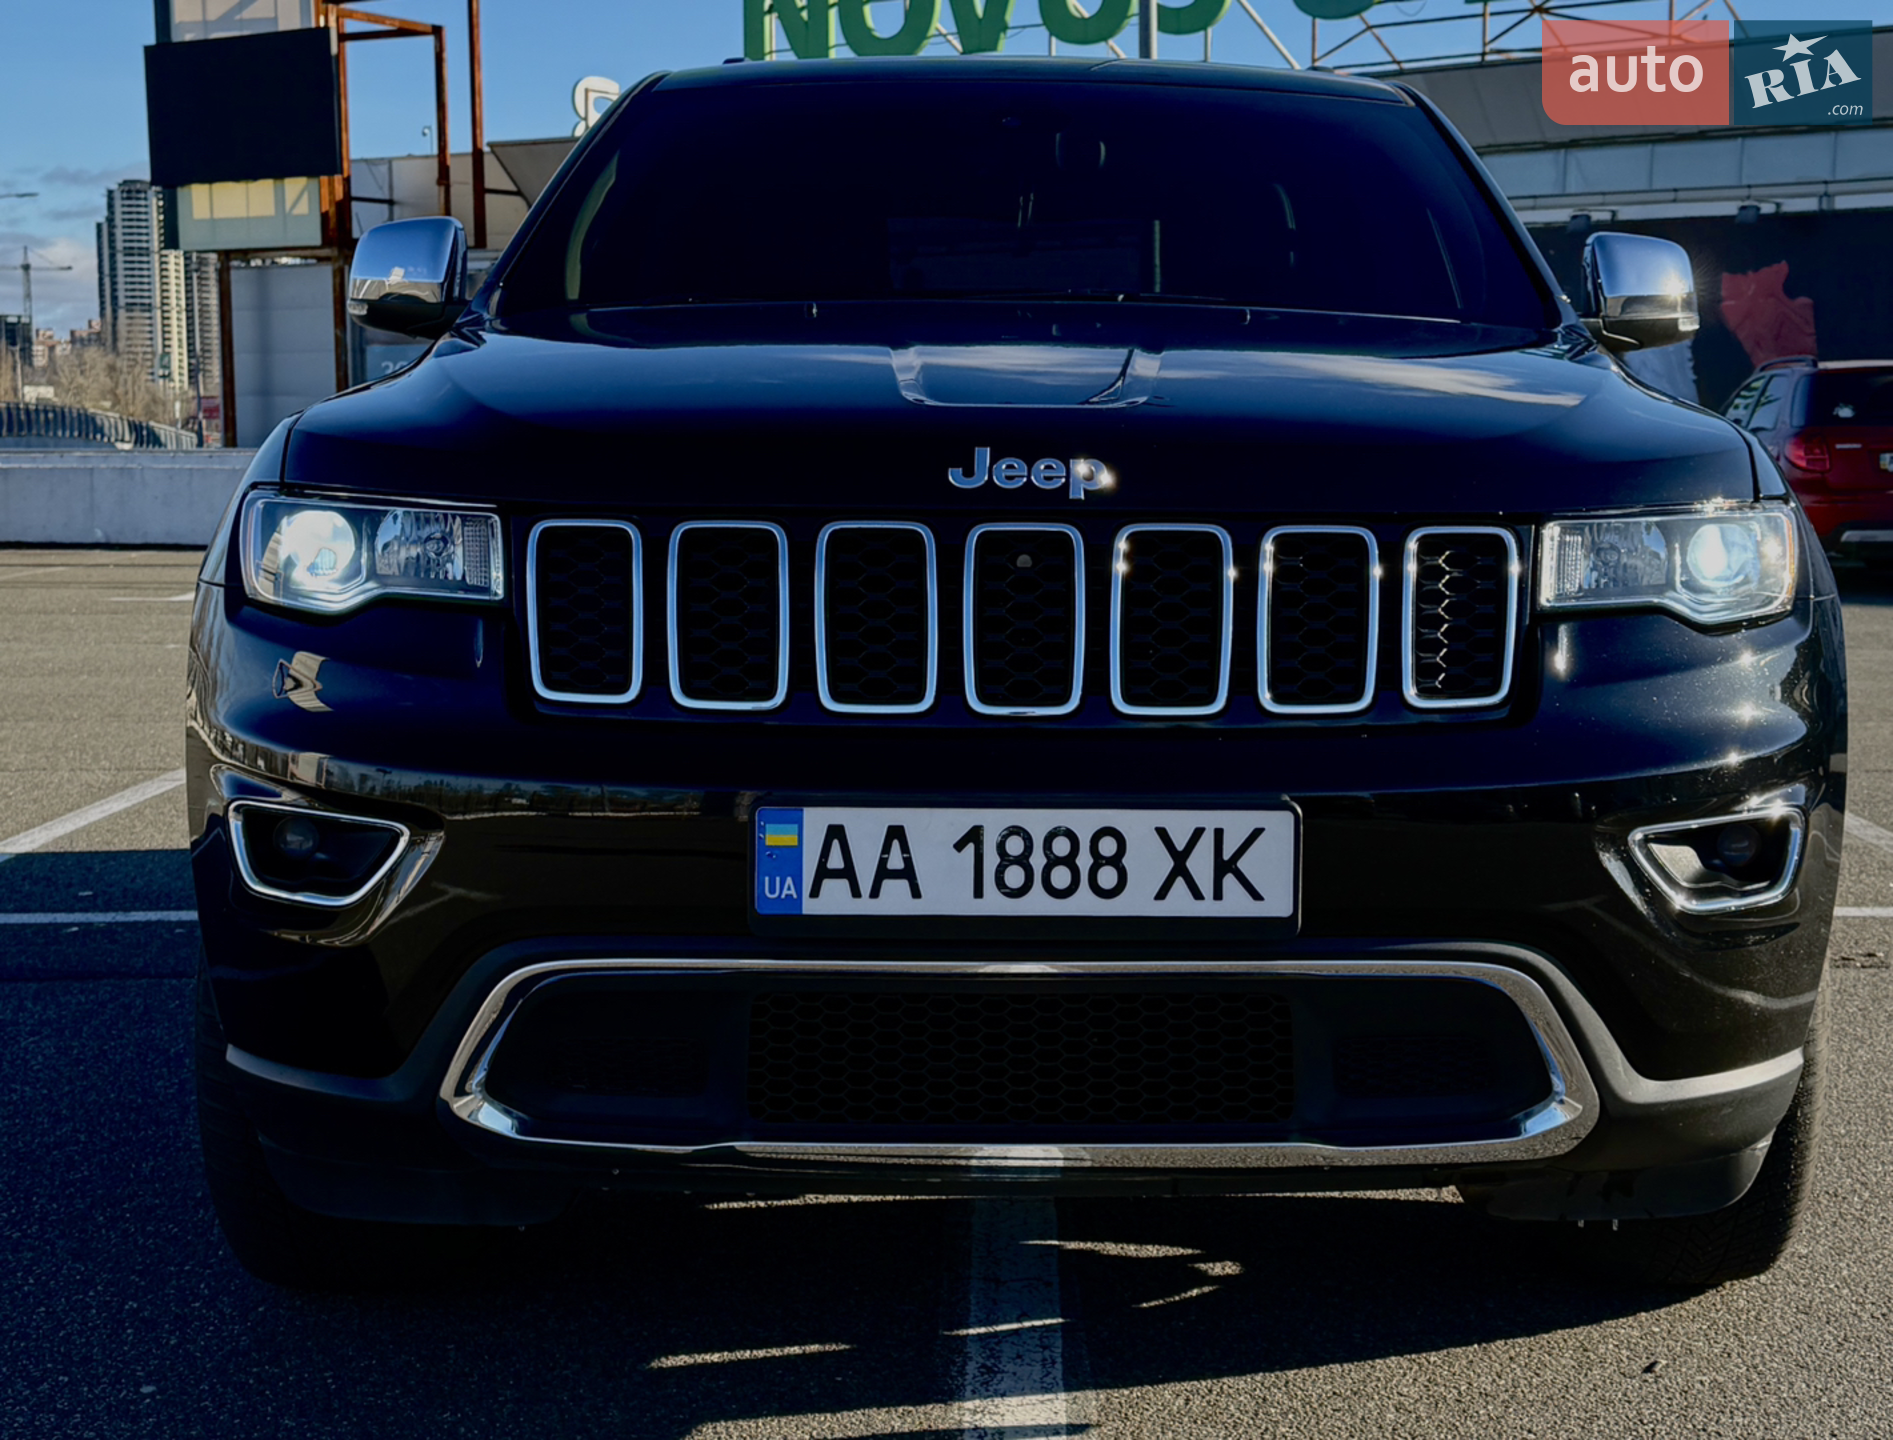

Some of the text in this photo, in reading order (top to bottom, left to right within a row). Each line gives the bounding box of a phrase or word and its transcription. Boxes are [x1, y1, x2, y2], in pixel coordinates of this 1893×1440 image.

[948, 446, 1113, 500] Jeep
[764, 876, 798, 899] UA
[808, 823, 1266, 902] AA 1888 XK
